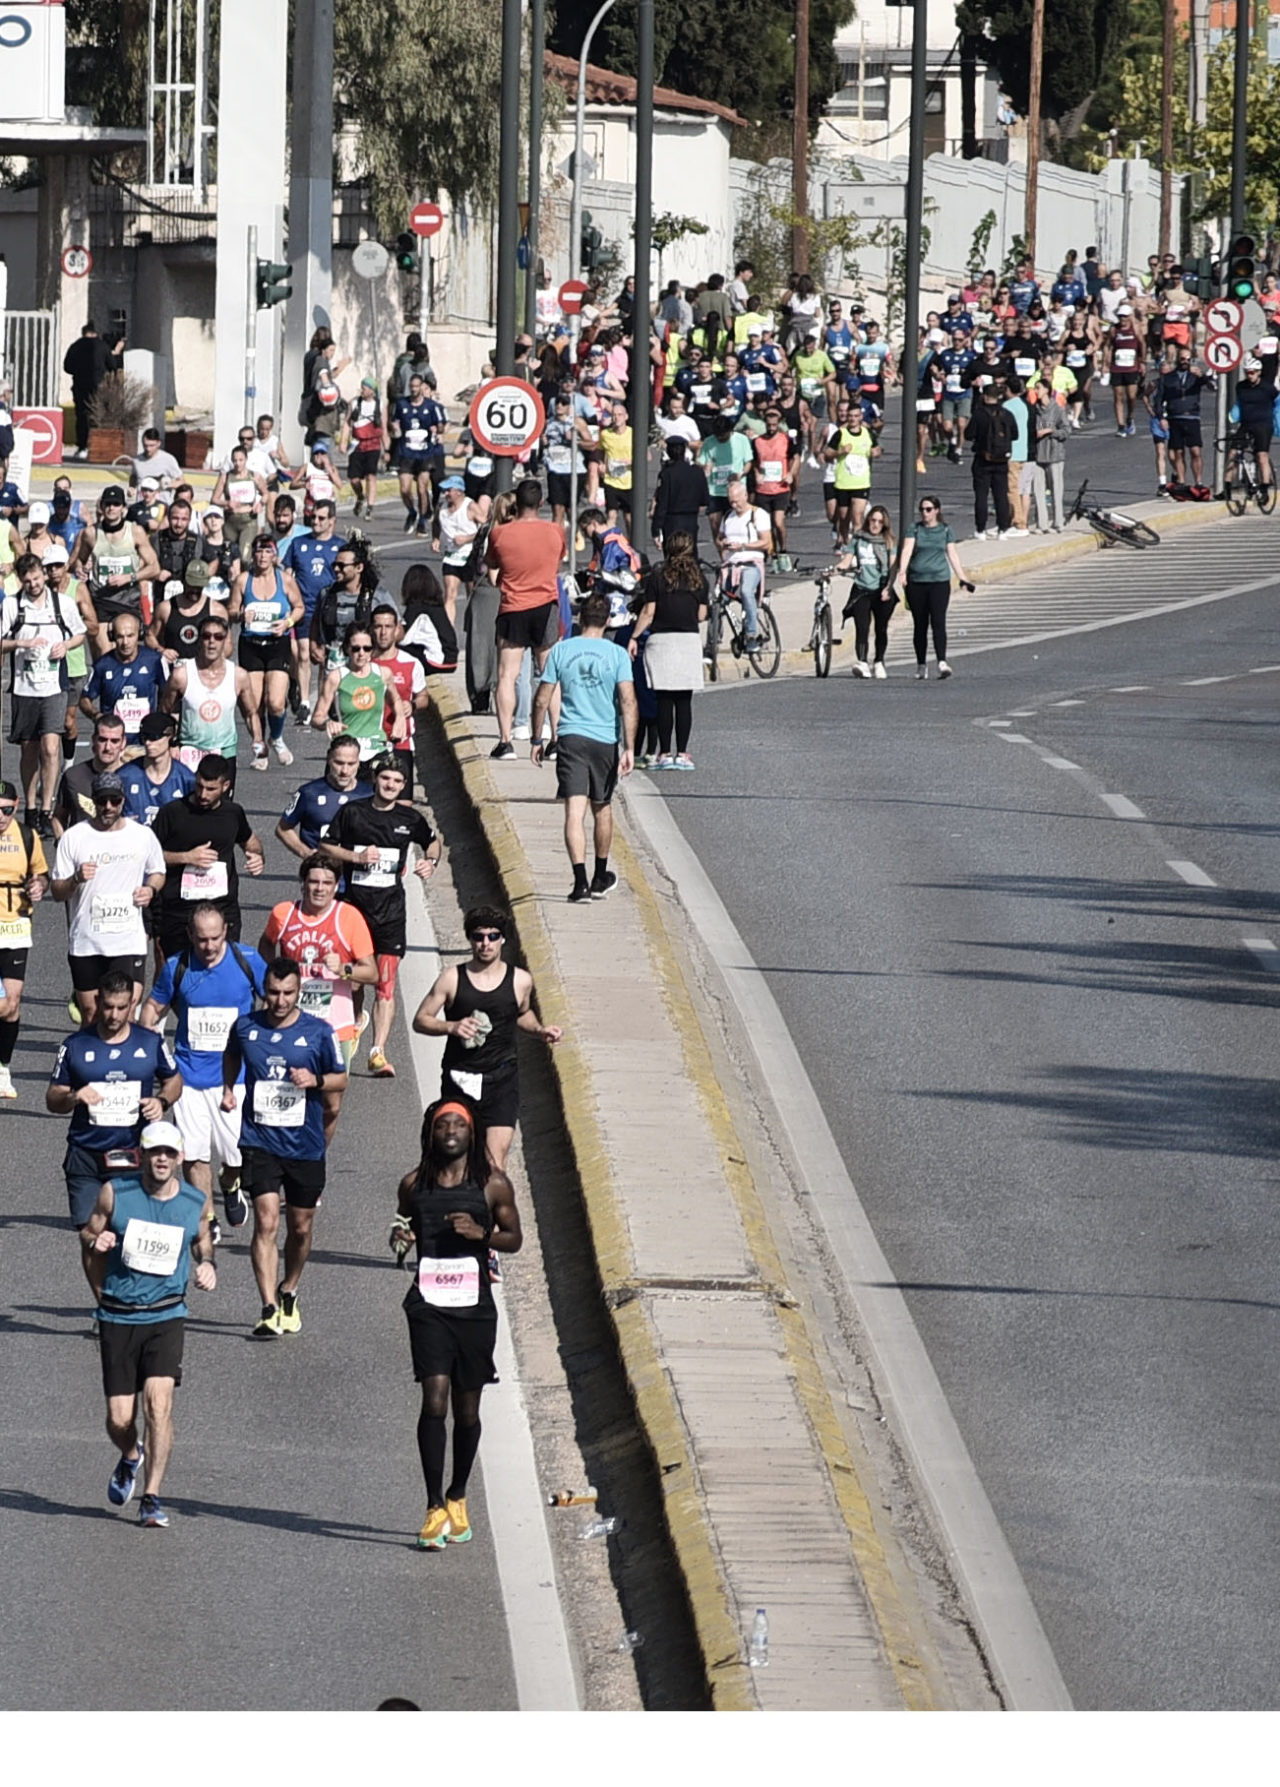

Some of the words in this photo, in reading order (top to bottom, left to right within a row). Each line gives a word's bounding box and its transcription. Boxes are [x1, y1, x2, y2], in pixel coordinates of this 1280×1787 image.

[486, 400, 528, 430] 60
[287, 930, 335, 951] ITALIA
[136, 1237, 170, 1255] 11599
